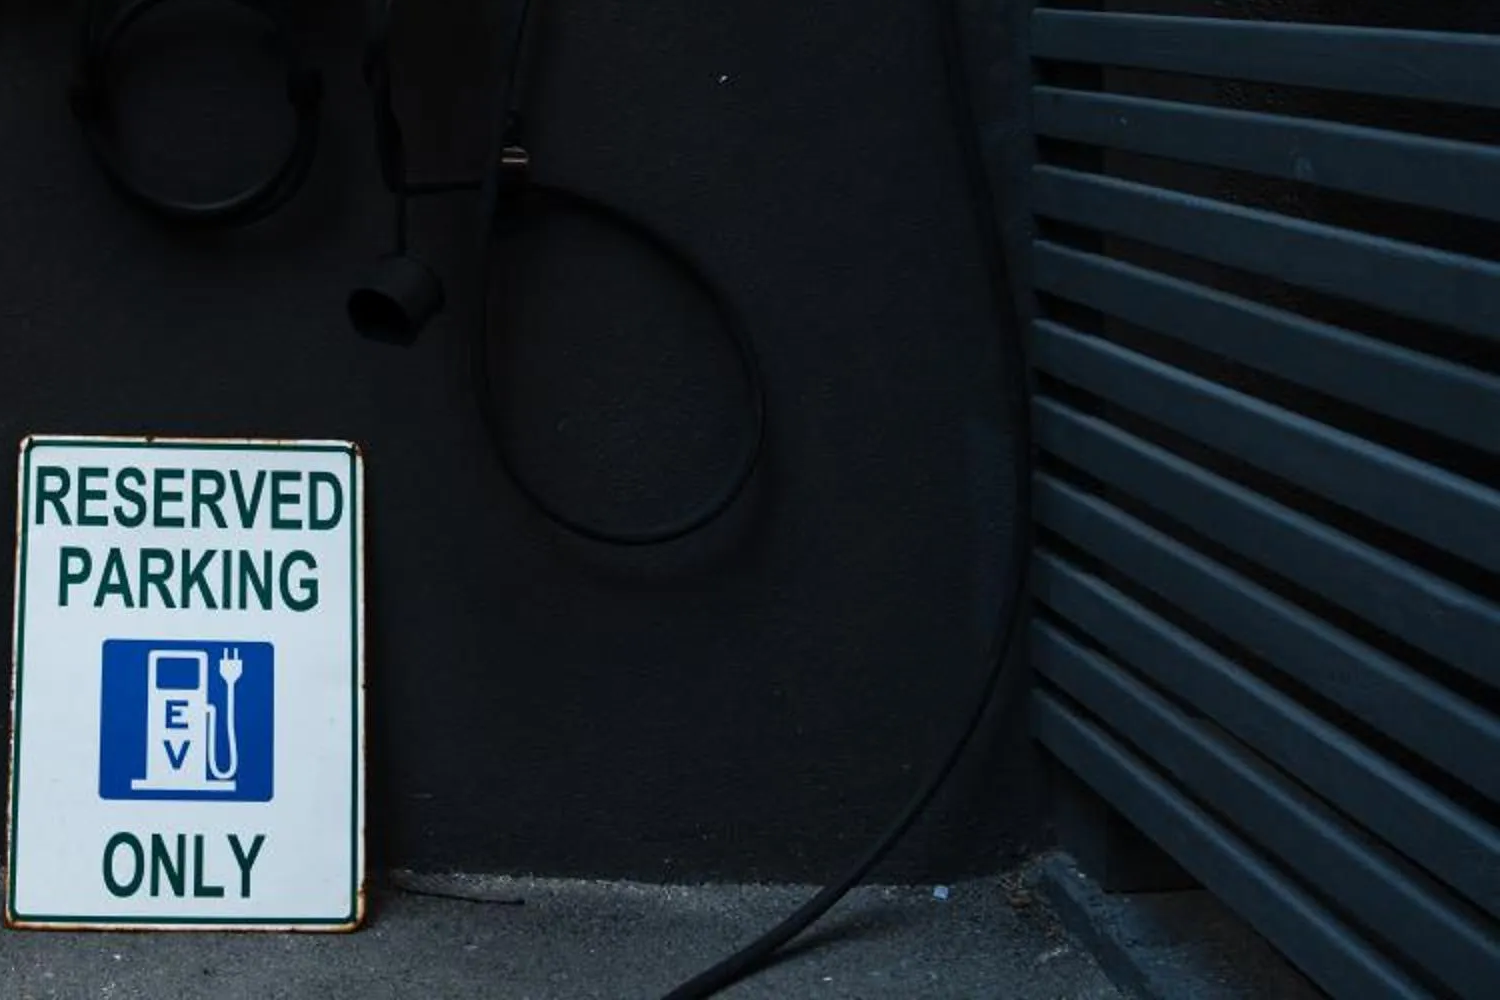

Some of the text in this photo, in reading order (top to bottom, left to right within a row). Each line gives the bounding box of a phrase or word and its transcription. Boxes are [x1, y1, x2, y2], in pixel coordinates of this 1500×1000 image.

[35, 466, 344, 531] RESERVED
[58, 547, 319, 612] PARKING
[102, 831, 266, 899] ONLY
